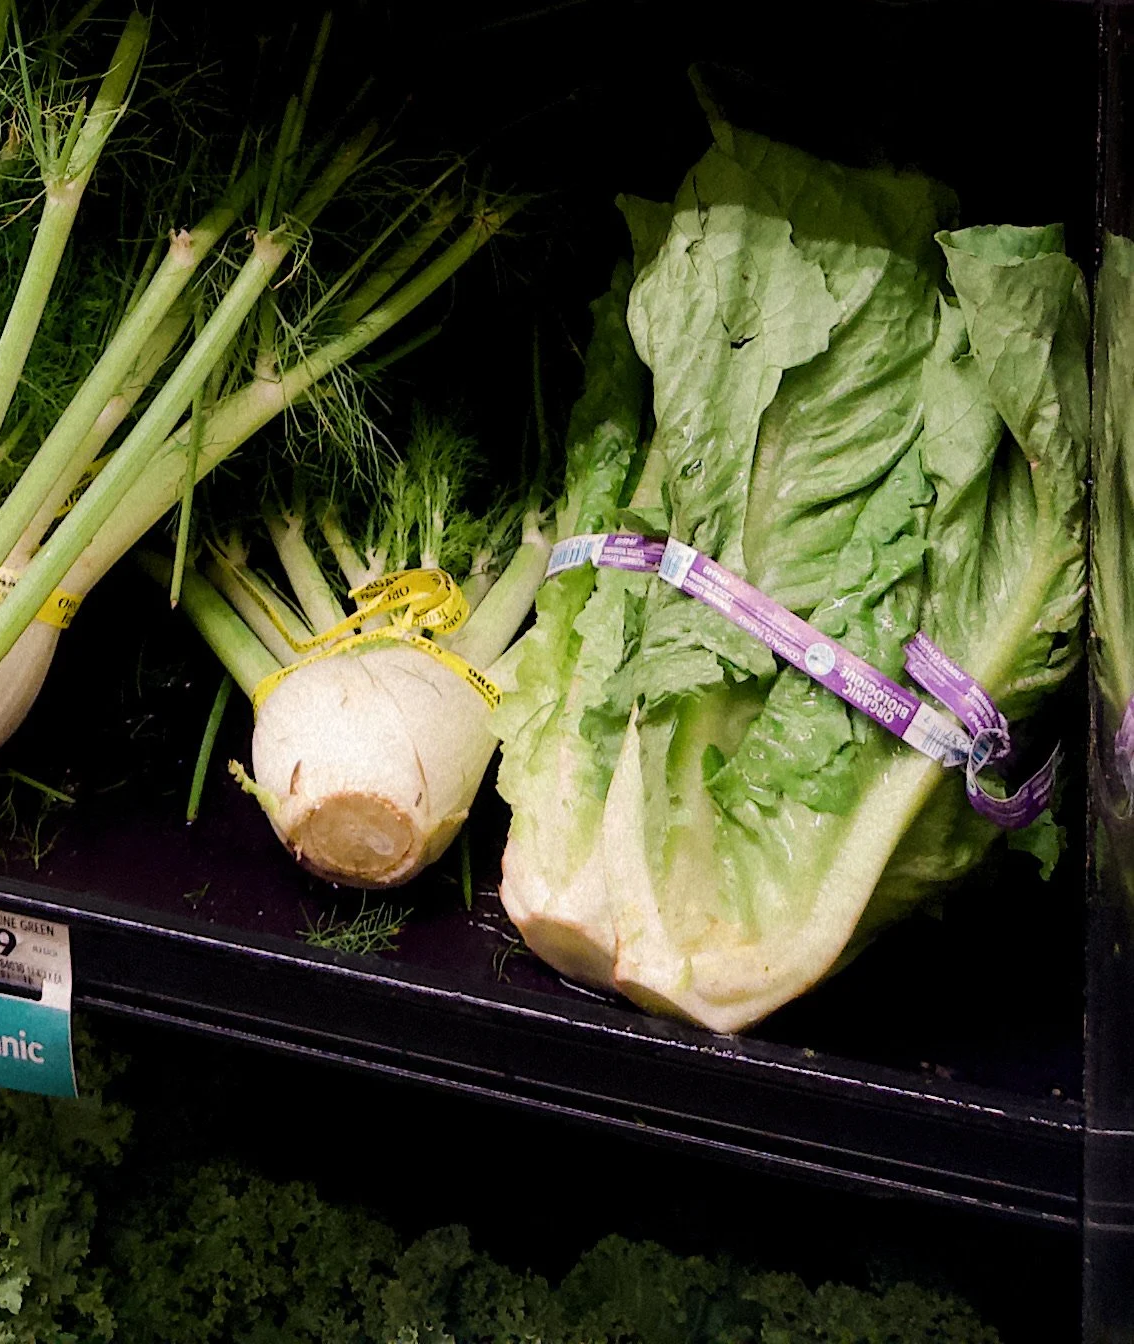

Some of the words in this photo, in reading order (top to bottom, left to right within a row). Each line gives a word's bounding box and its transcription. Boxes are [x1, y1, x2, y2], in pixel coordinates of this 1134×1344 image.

[467, 667, 501, 704] ORGA
[839, 665, 911, 720] BIOLOGIQUE
[841, 676, 895, 724] ORGANIC
[20, 919, 54, 937] GREEN
